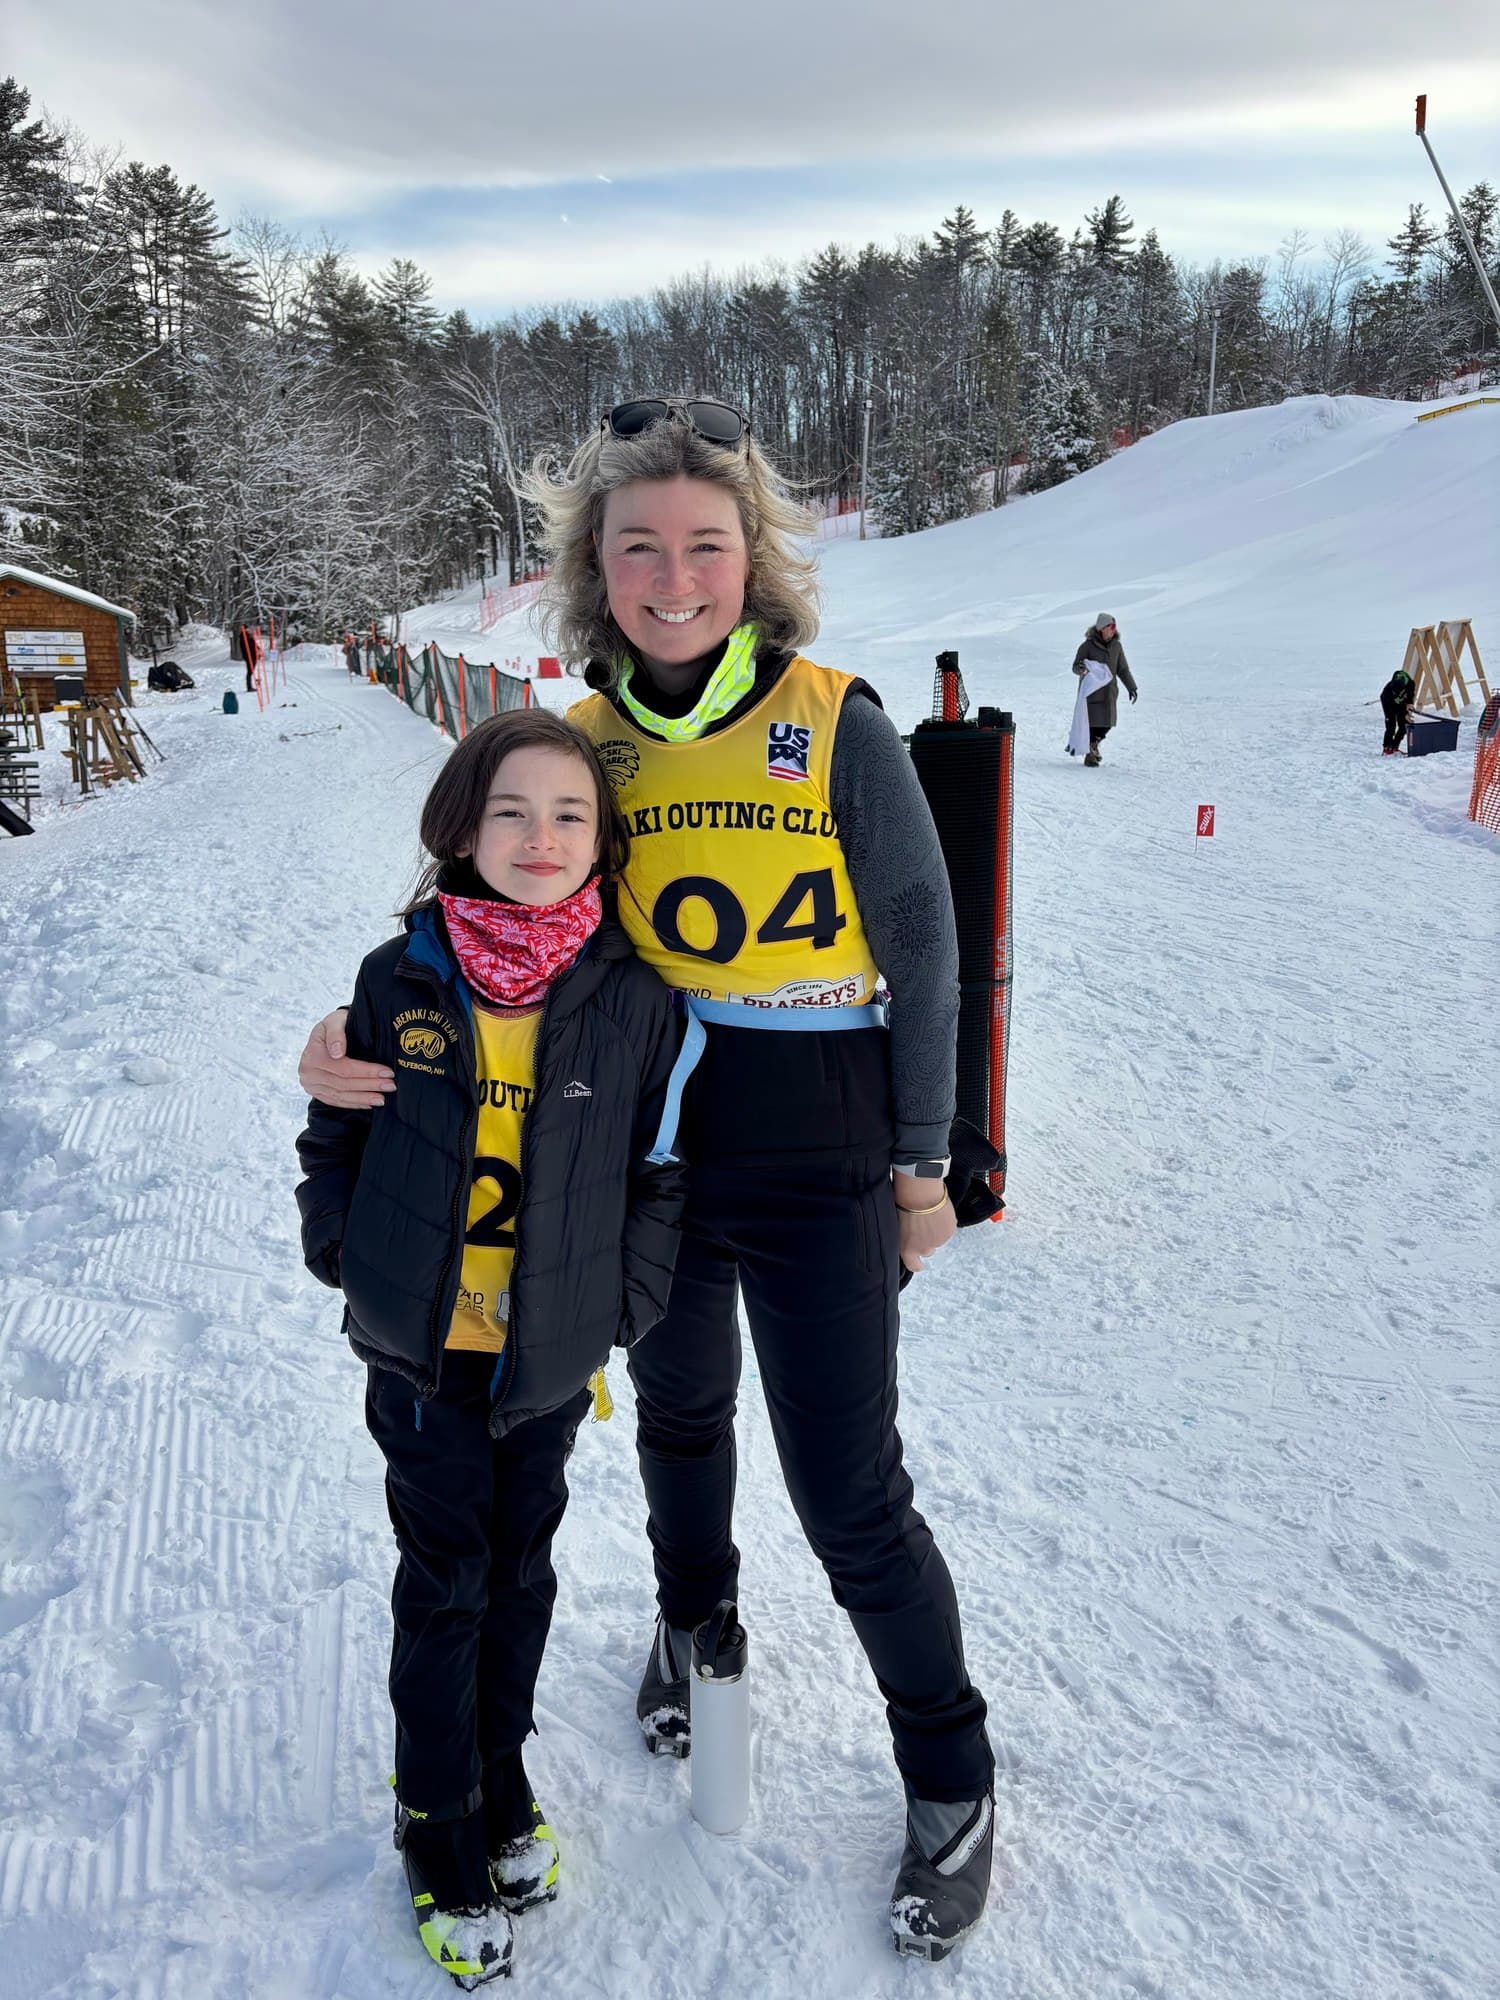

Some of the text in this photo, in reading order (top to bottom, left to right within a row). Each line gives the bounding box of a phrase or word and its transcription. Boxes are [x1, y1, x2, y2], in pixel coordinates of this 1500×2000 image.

[607, 748, 621, 756] SKI
[769, 722, 810, 750] US
[667, 801, 776, 831] OUTING
[782, 806, 840, 840] CLU
[652, 867, 847, 965] 04
[392, 1008, 427, 1031] ABENAKI
[428, 1010, 444, 1024] SKI
[478, 1078, 536, 1114] OUTI
[464, 1156, 522, 1248] 2
